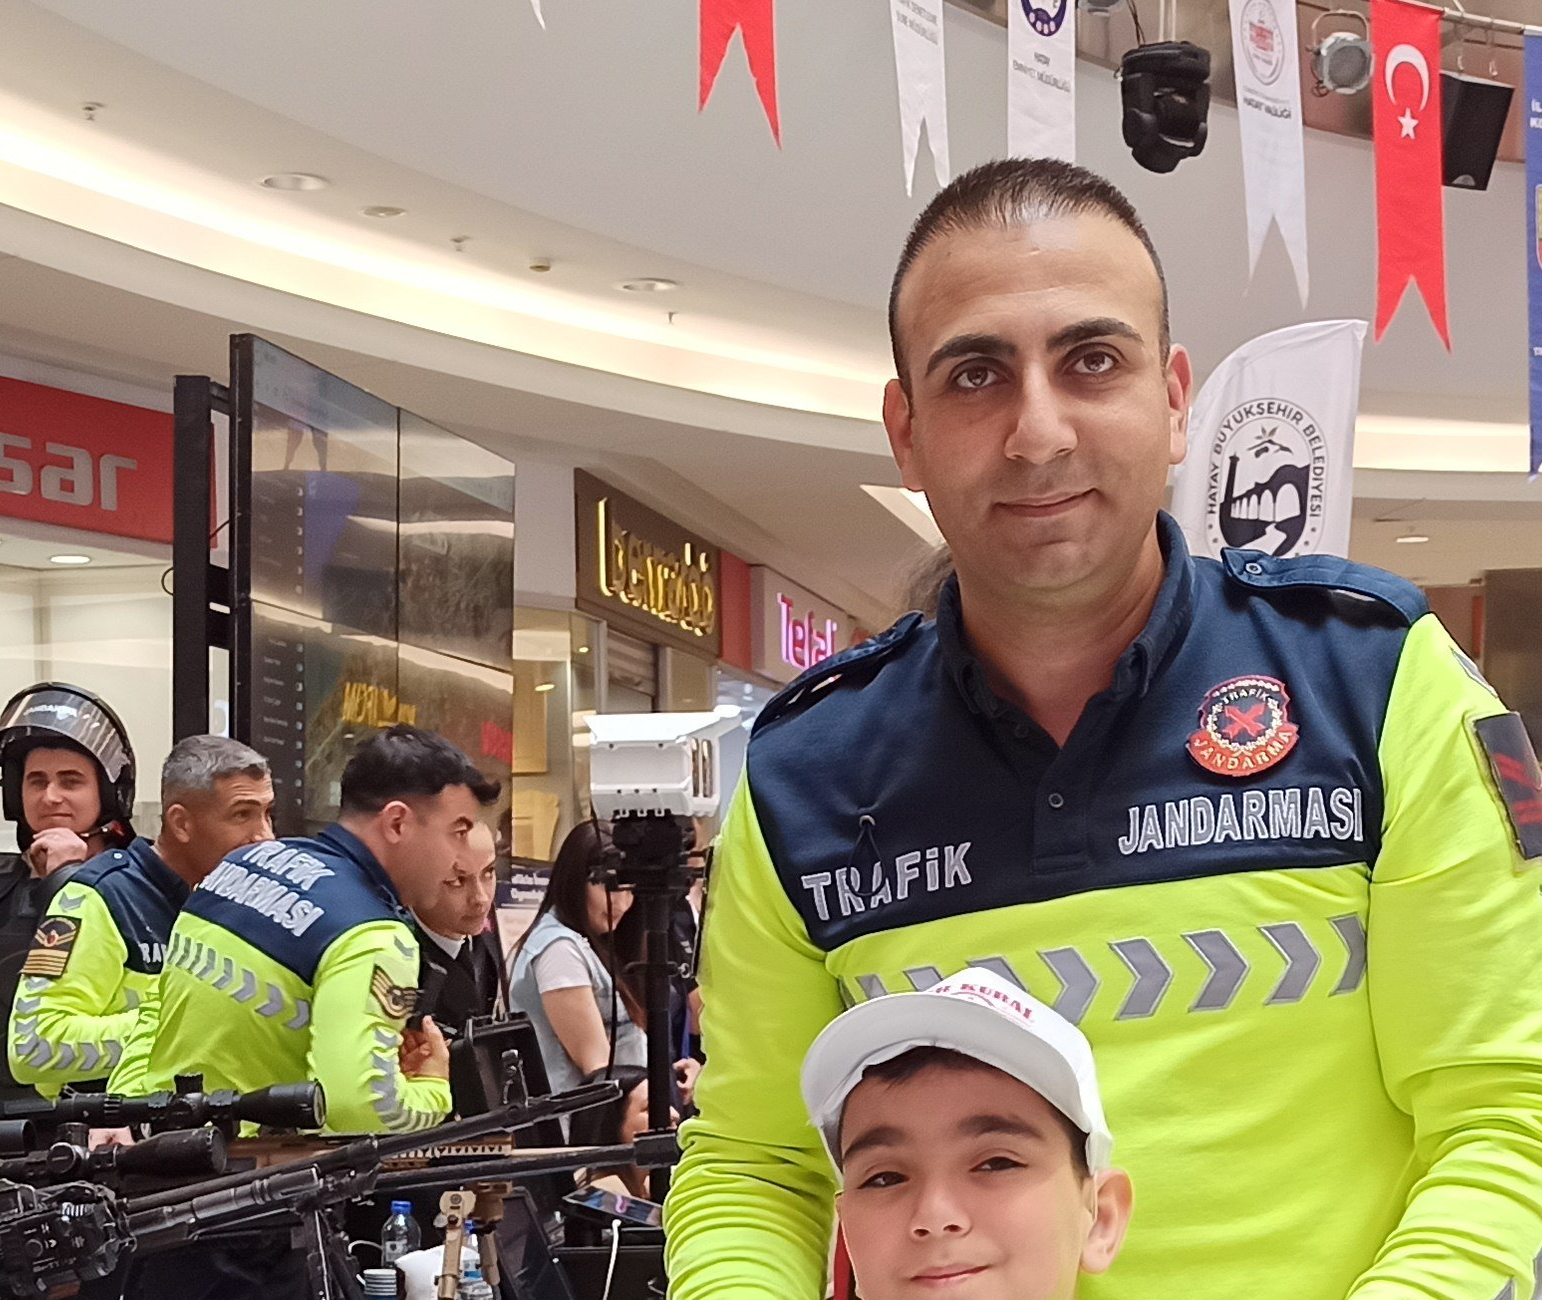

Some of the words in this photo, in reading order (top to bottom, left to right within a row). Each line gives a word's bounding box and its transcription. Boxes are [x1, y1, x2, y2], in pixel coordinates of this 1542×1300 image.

[1208, 464, 1220, 515] HATAY
[1221, 689, 1271, 704] TRAFİK
[1193, 730, 1294, 770] JANDARMA
[1119, 787, 1365, 856] JANDARMASI
[199, 860, 325, 937] ANDARMASI
[801, 842, 973, 922] TRAFİK
